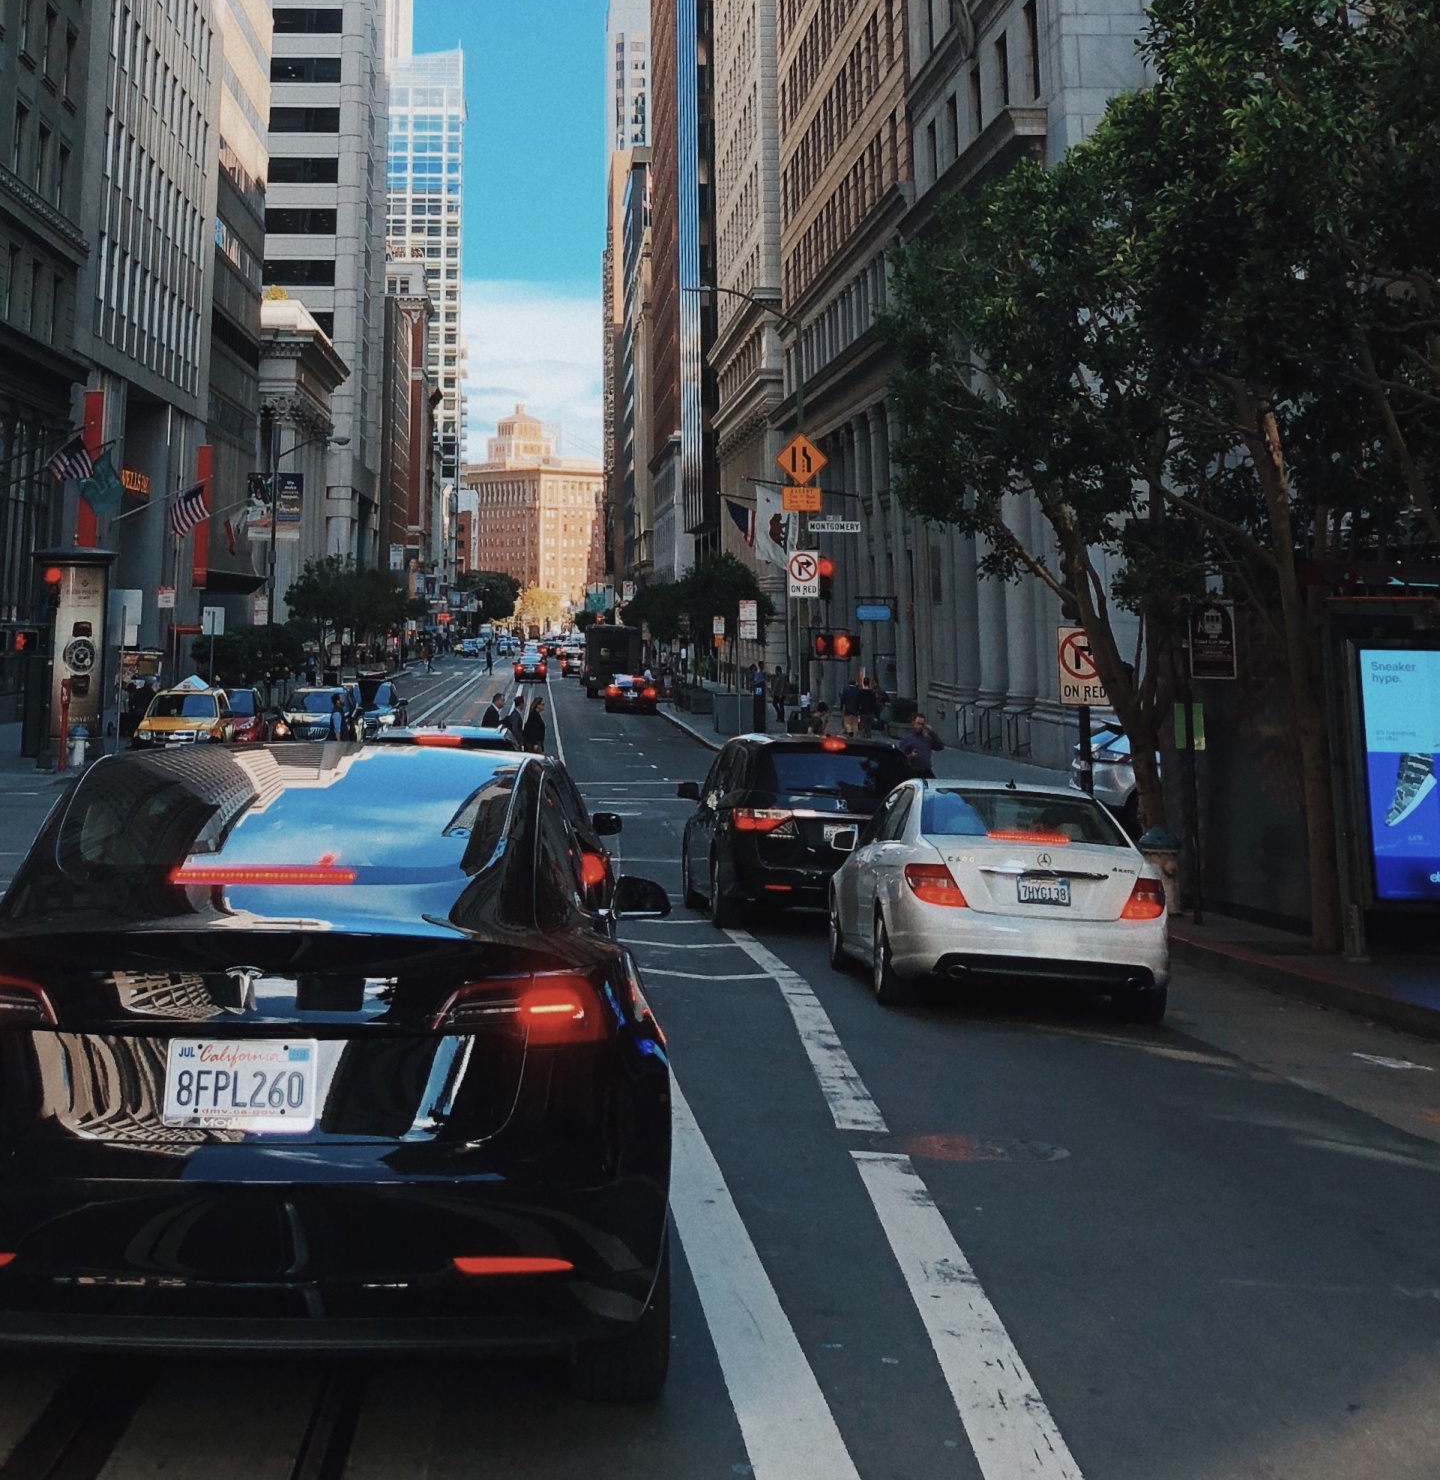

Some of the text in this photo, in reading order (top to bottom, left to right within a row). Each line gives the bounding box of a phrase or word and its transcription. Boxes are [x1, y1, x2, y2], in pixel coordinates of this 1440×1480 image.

[809, 522, 860, 531] MONTGOMERY
[791, 584, 817, 594] ON RED
[1370, 661, 1416, 672] Sneaker
[1372, 673, 1402, 685] hype.
[1063, 684, 1107, 699] ON RED
[1021, 885, 1067, 901] 7HYG138
[178, 1046, 196, 1058] JUL
[200, 1044, 281, 1068] California
[176, 1069, 304, 1108] 8FPL260
[202, 1108, 276, 1117] dmv.ca.gov
